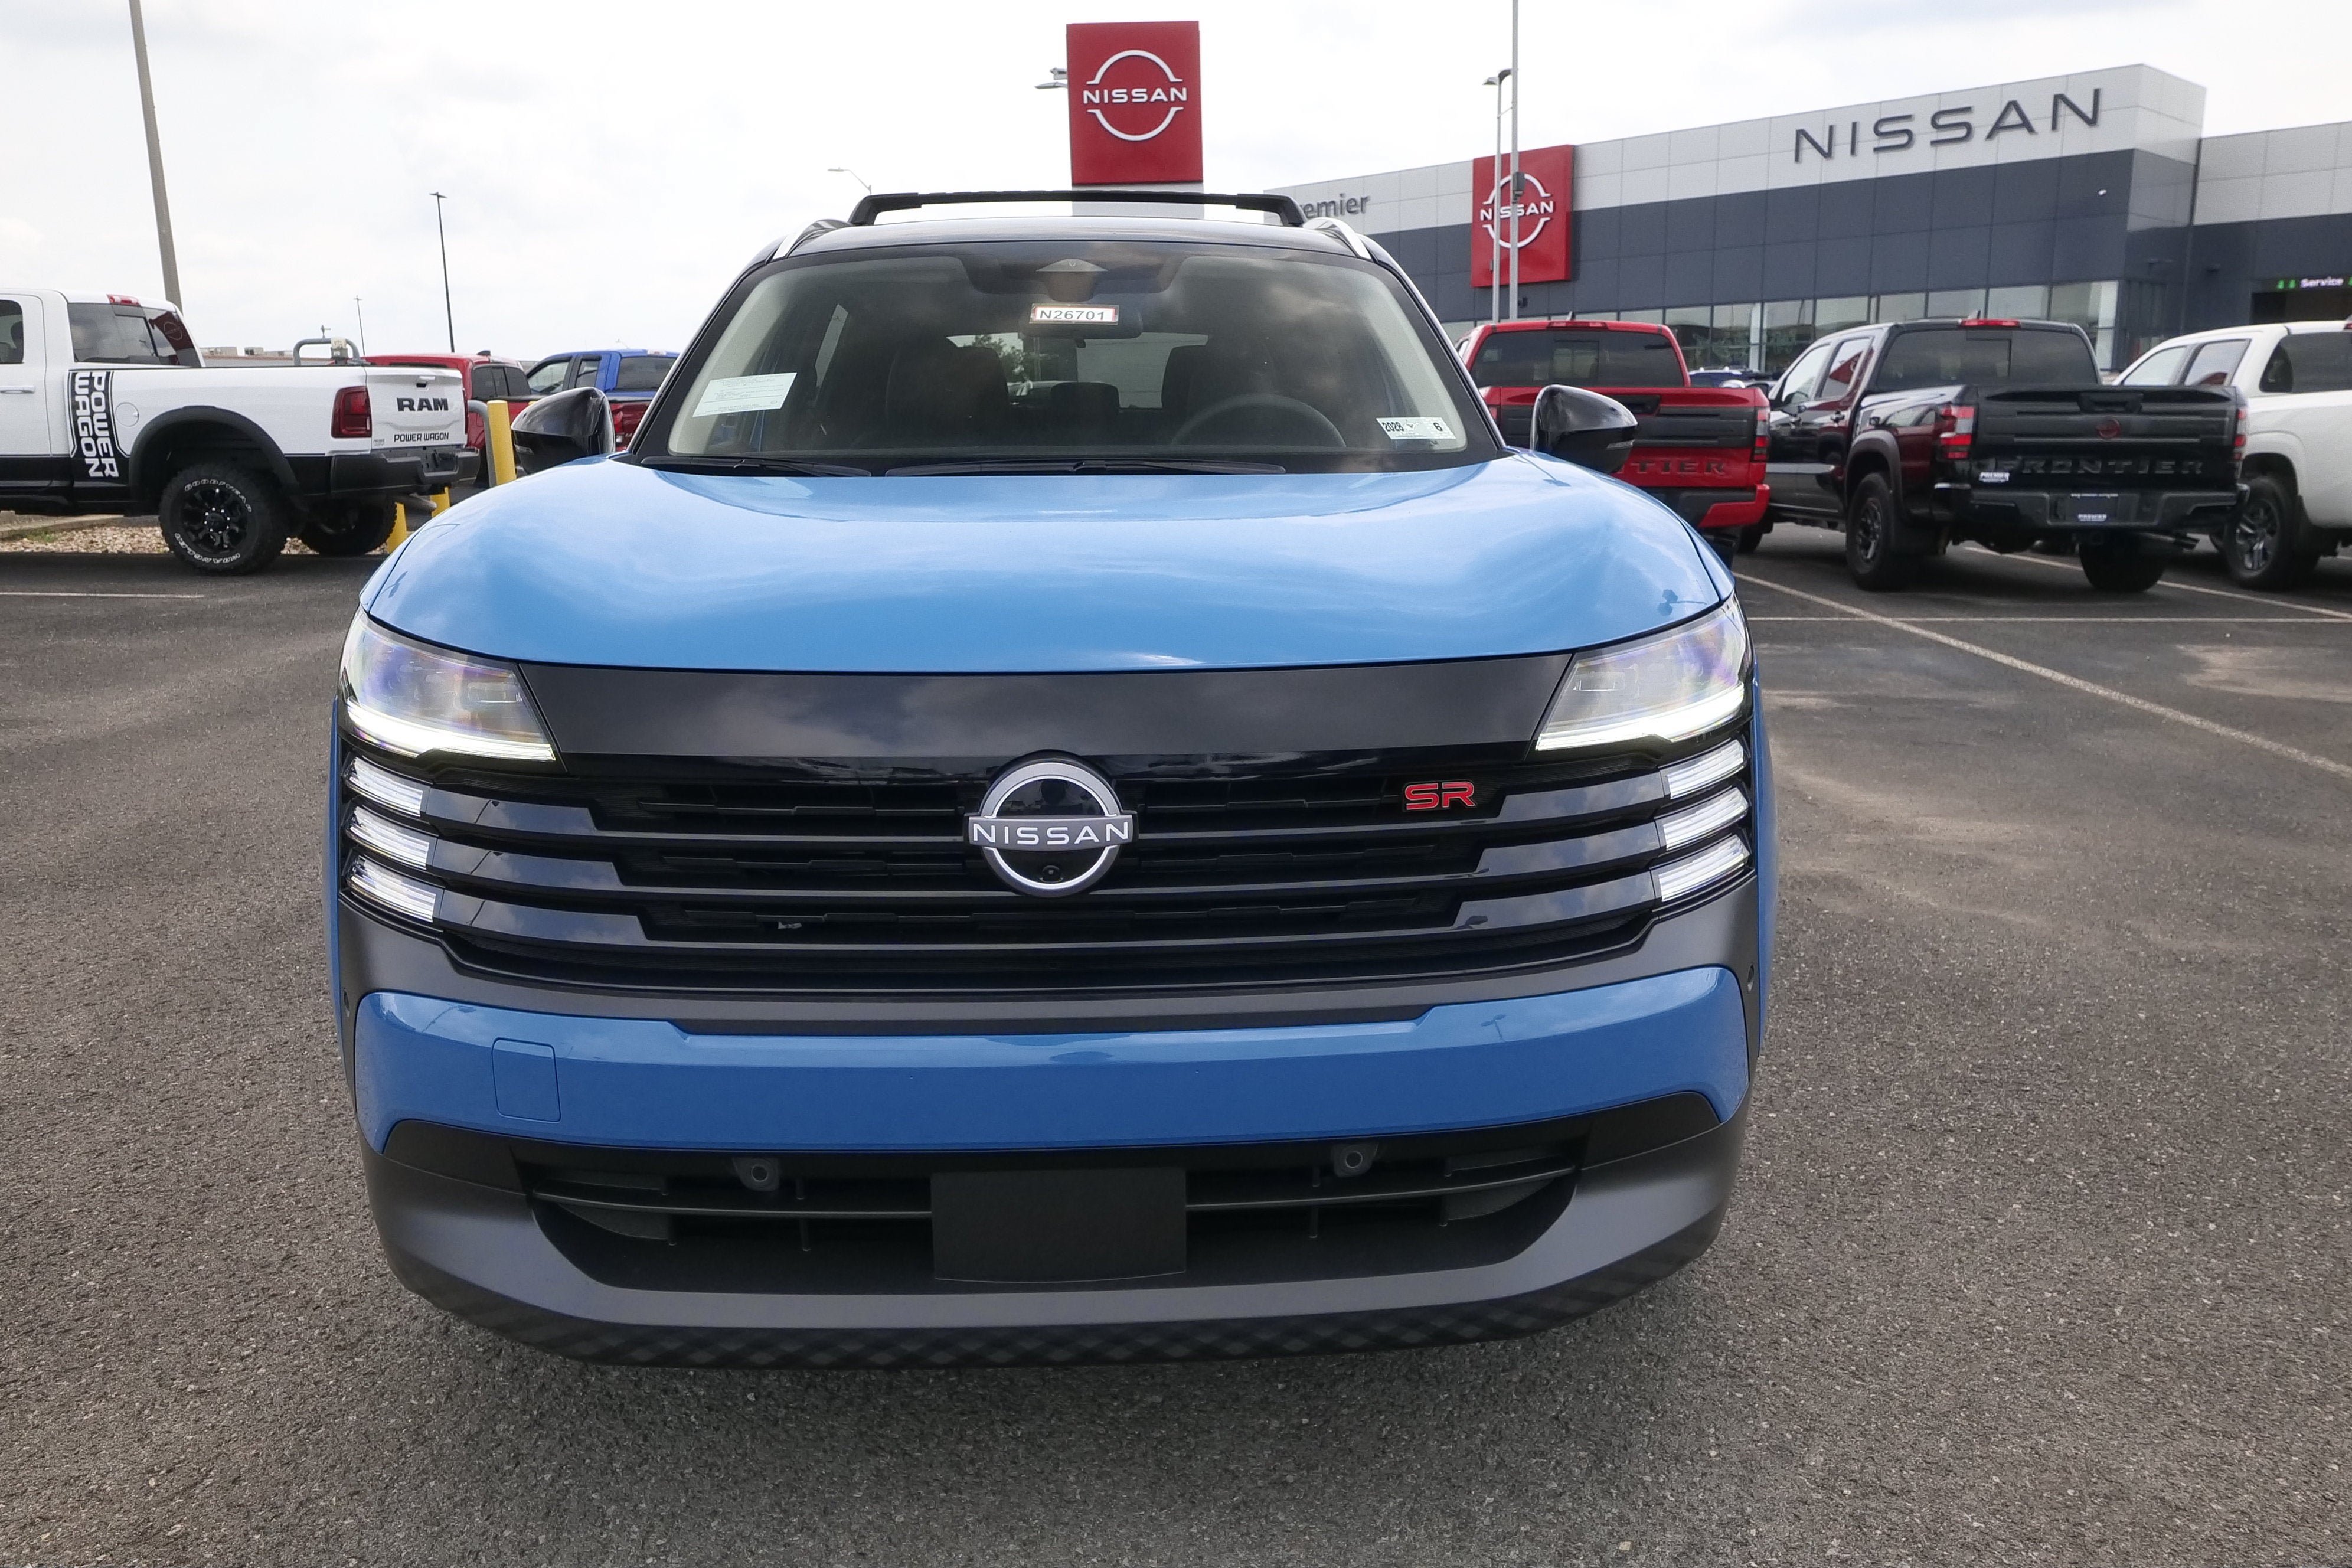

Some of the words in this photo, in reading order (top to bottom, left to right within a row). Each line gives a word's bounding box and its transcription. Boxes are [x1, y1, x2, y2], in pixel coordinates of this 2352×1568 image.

[1083, 87, 1187, 104] NISSAN
[1795, 88, 2101, 164] NISSAN
[1480, 201, 1554, 221] NSSAN
[1040, 310, 1104, 320] N26701
[397, 397, 449, 411] RAM
[74, 371, 104, 477] WAGON
[91, 371, 119, 477] POWER
[1382, 422, 1404, 432] 2028
[1433, 422, 1443, 432] 6
[394, 433, 422, 442] POWER
[423, 432, 449, 441] WAGON
[1404, 781, 1476, 810] SR
[973, 821, 1129, 845] NISSAN
